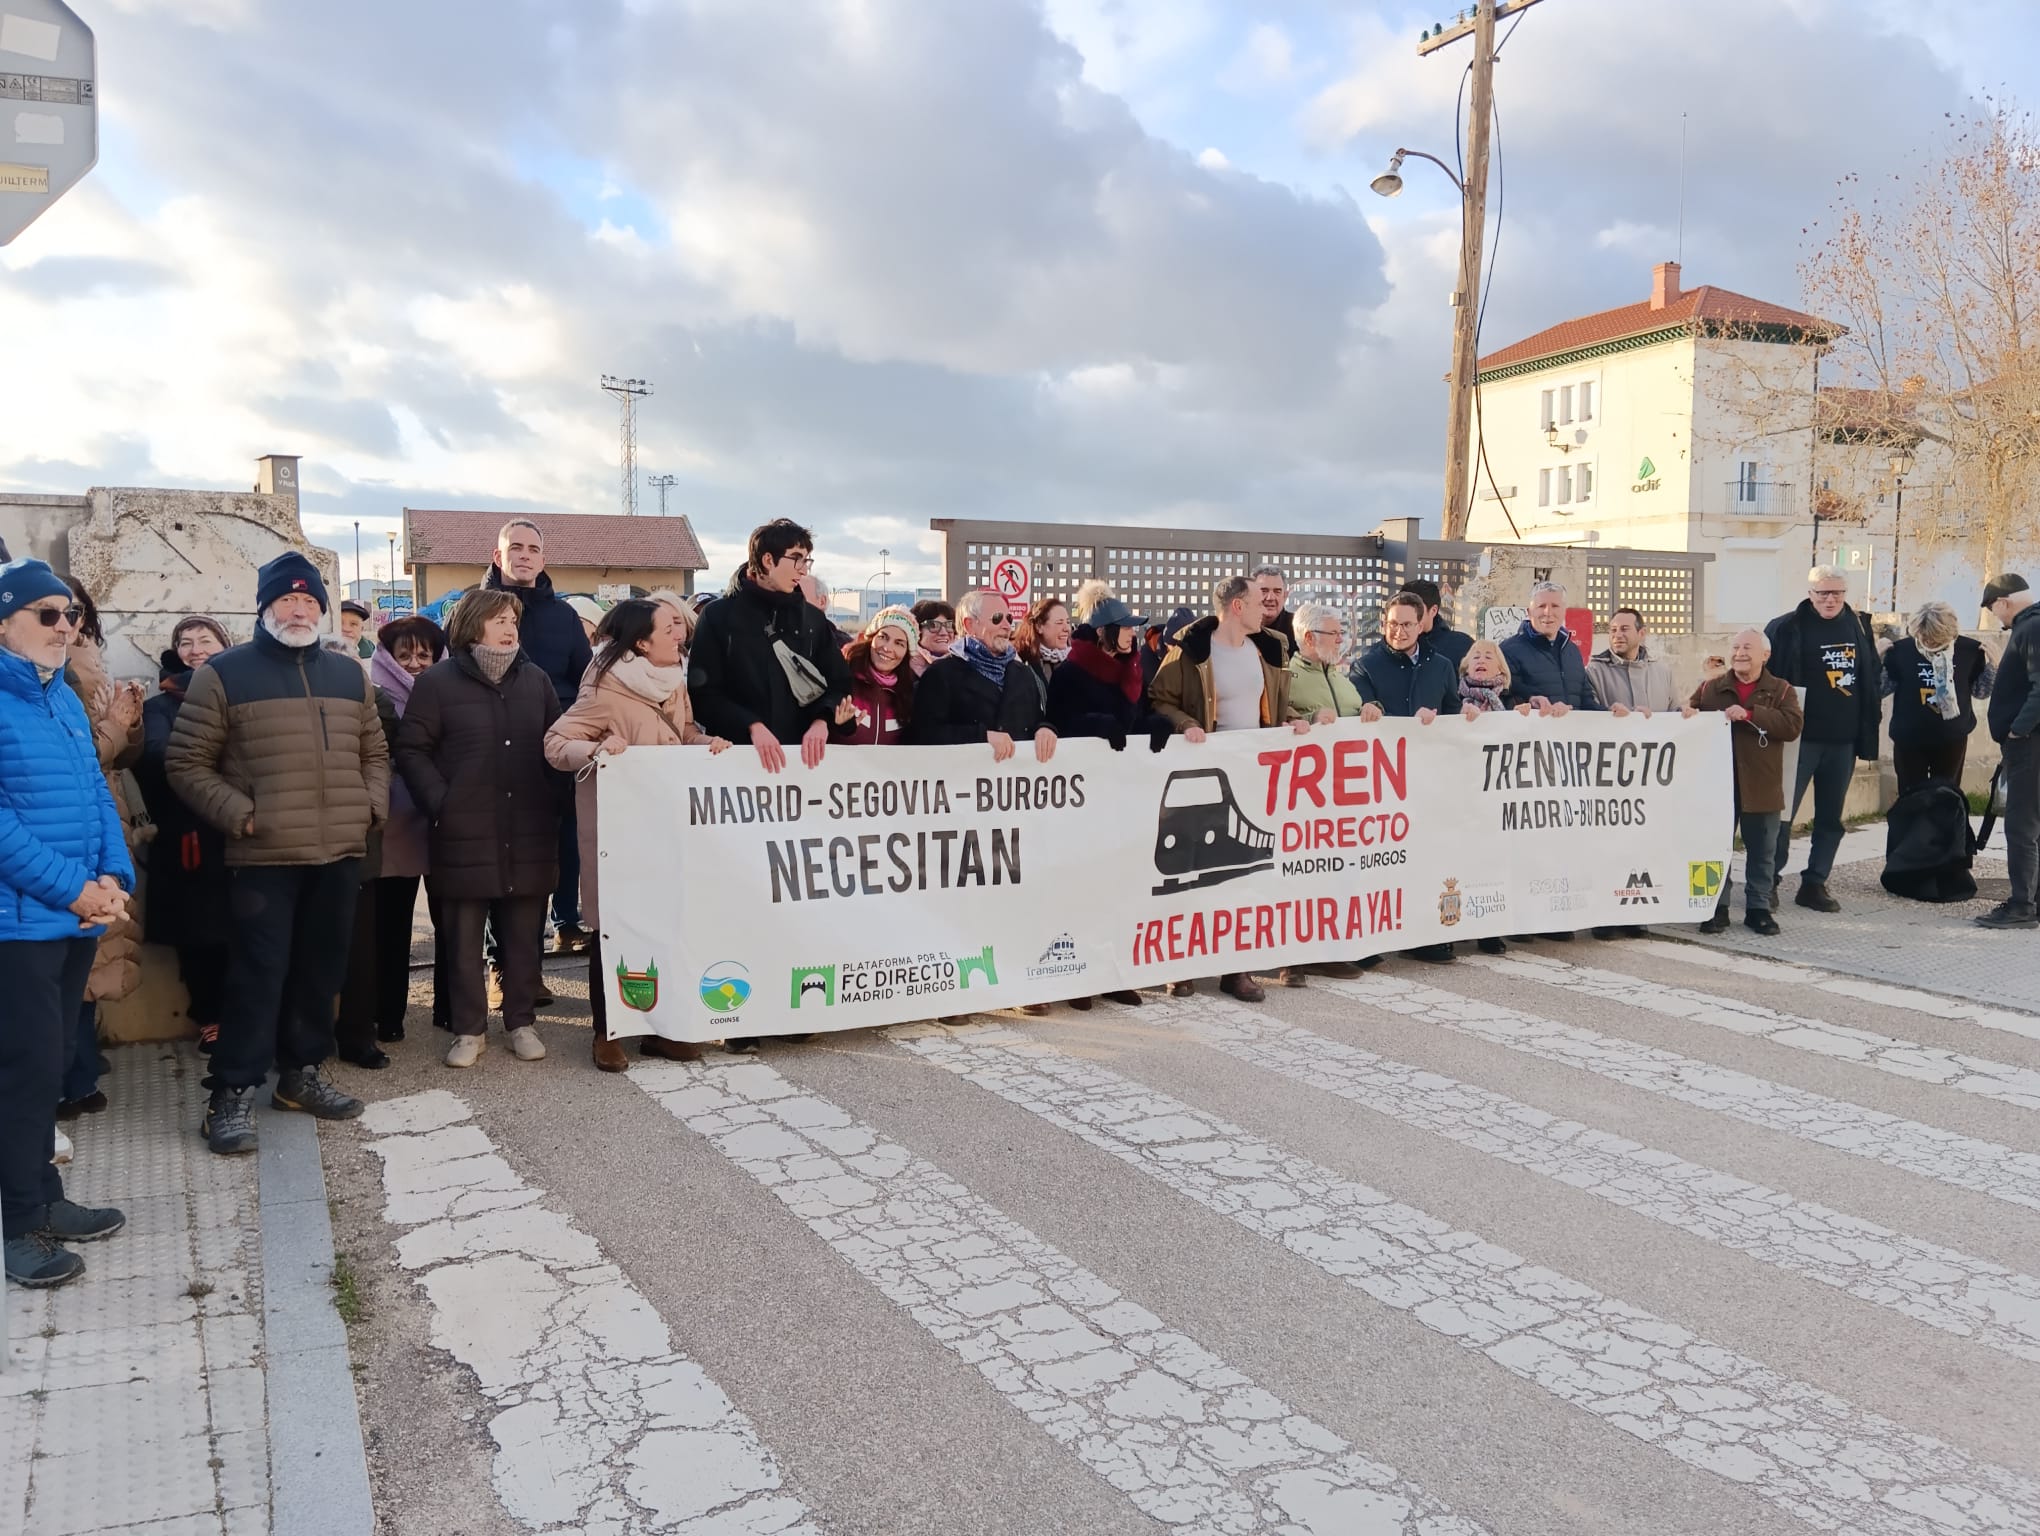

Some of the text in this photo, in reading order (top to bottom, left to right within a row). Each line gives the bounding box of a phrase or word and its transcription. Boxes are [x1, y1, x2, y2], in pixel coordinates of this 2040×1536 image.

[1631, 478, 1661, 493] adif
[1851, 550, 1860, 565] P
[1826, 659, 1855, 670] TREN
[1257, 737, 1407, 816] TREN
[688, 784, 802, 826] MADRID
[828, 779, 951, 819] SEGOVIA
[976, 773, 1086, 813] BURGOS
[1282, 812, 1410, 853] DIRECTO
[765, 827, 1021, 904] NECESITAN
[1282, 856, 1345, 877] MADRID
[1360, 850, 1407, 871] BURGOS
[1465, 890, 1506, 909] Aranda
[1614, 889, 1641, 897] SIERRA
[1475, 904, 1507, 919] Duero
[843, 951, 951, 973] PLATAFORMA POR EL
[842, 961, 955, 991] FC DIRECTO
[841, 988, 894, 1004] MADRID
[906, 980, 956, 997] BURGOS
[709, 1016, 740, 1026] CODINSE
